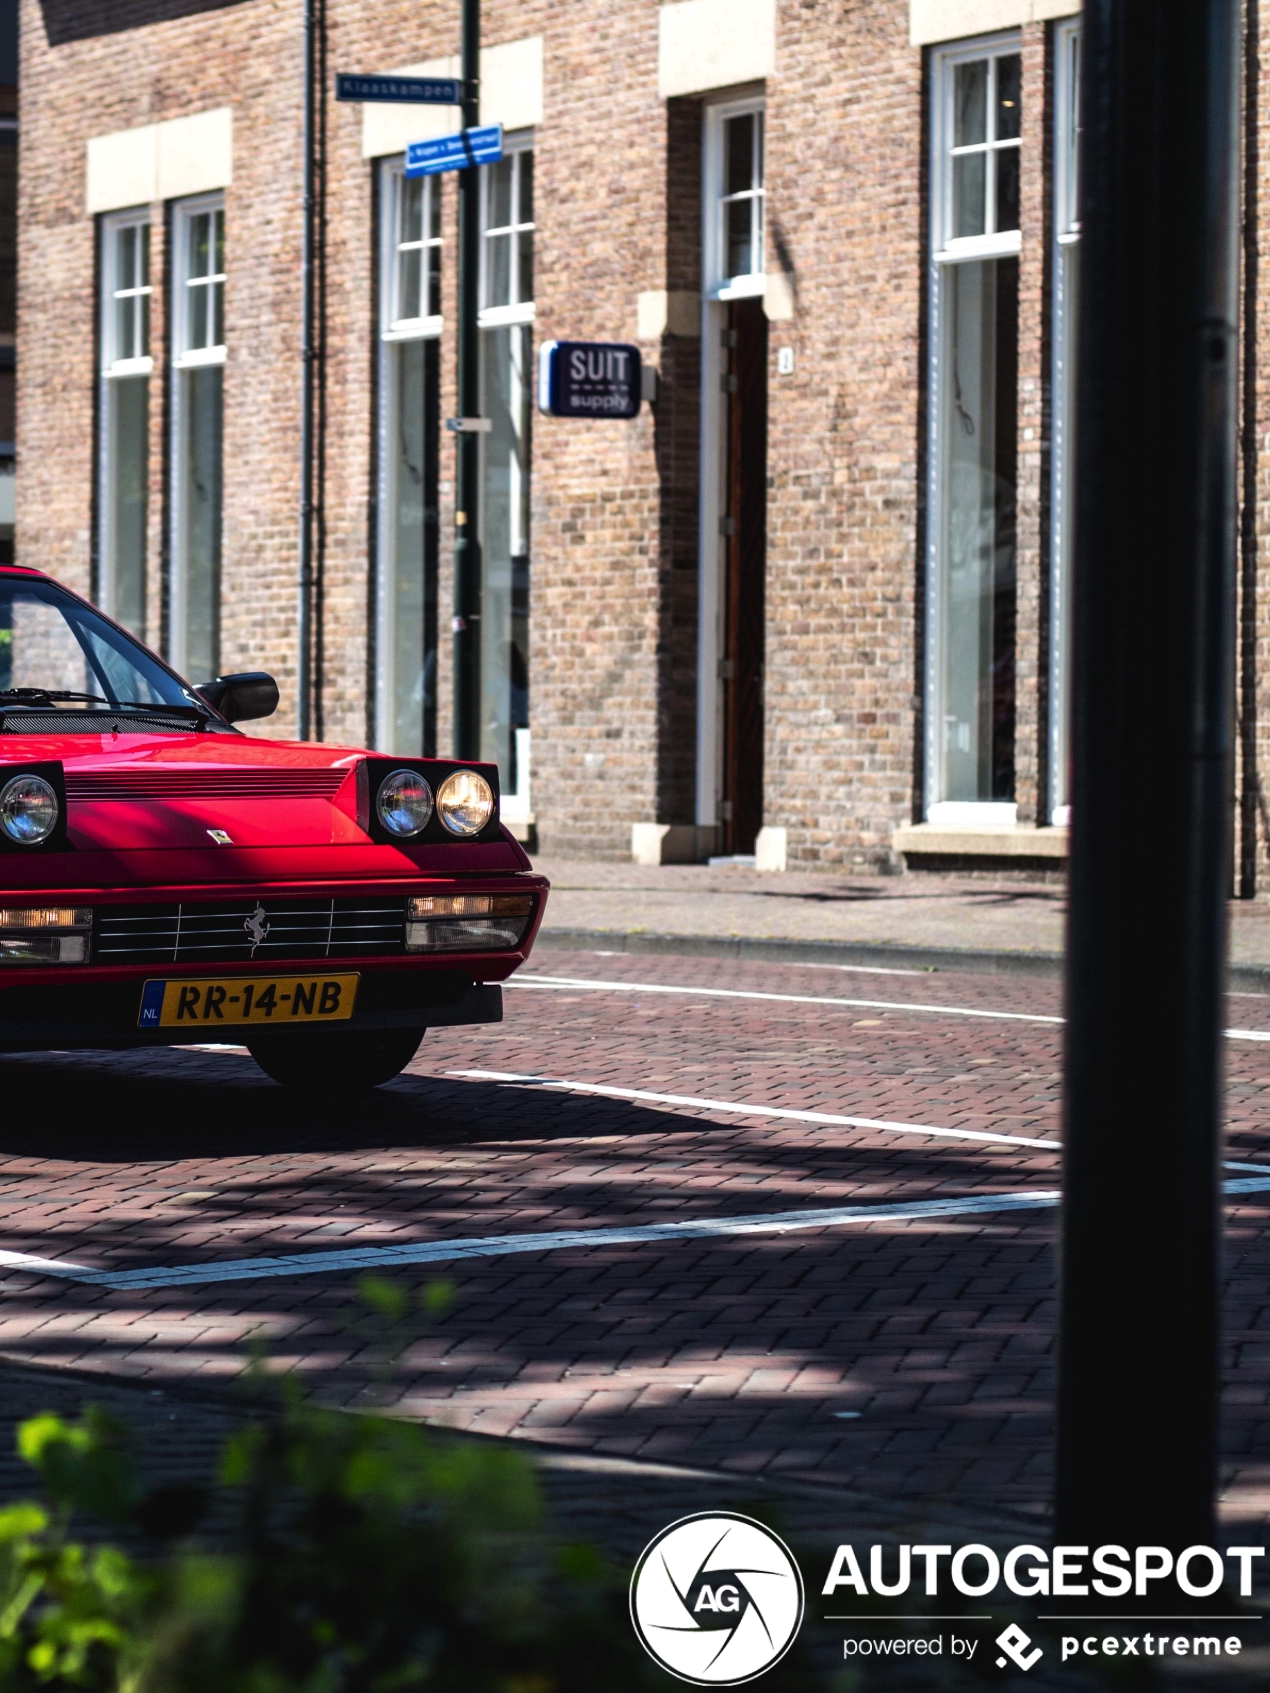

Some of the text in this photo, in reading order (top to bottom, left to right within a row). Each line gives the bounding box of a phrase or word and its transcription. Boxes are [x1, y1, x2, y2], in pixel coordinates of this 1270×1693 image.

[342, 80, 454, 99] Klaaskampen
[570, 350, 629, 381] SUIT
[570, 394, 629, 411] supply
[176, 981, 342, 1020] RR-14-NB
[142, 1008, 158, 1020] NL
